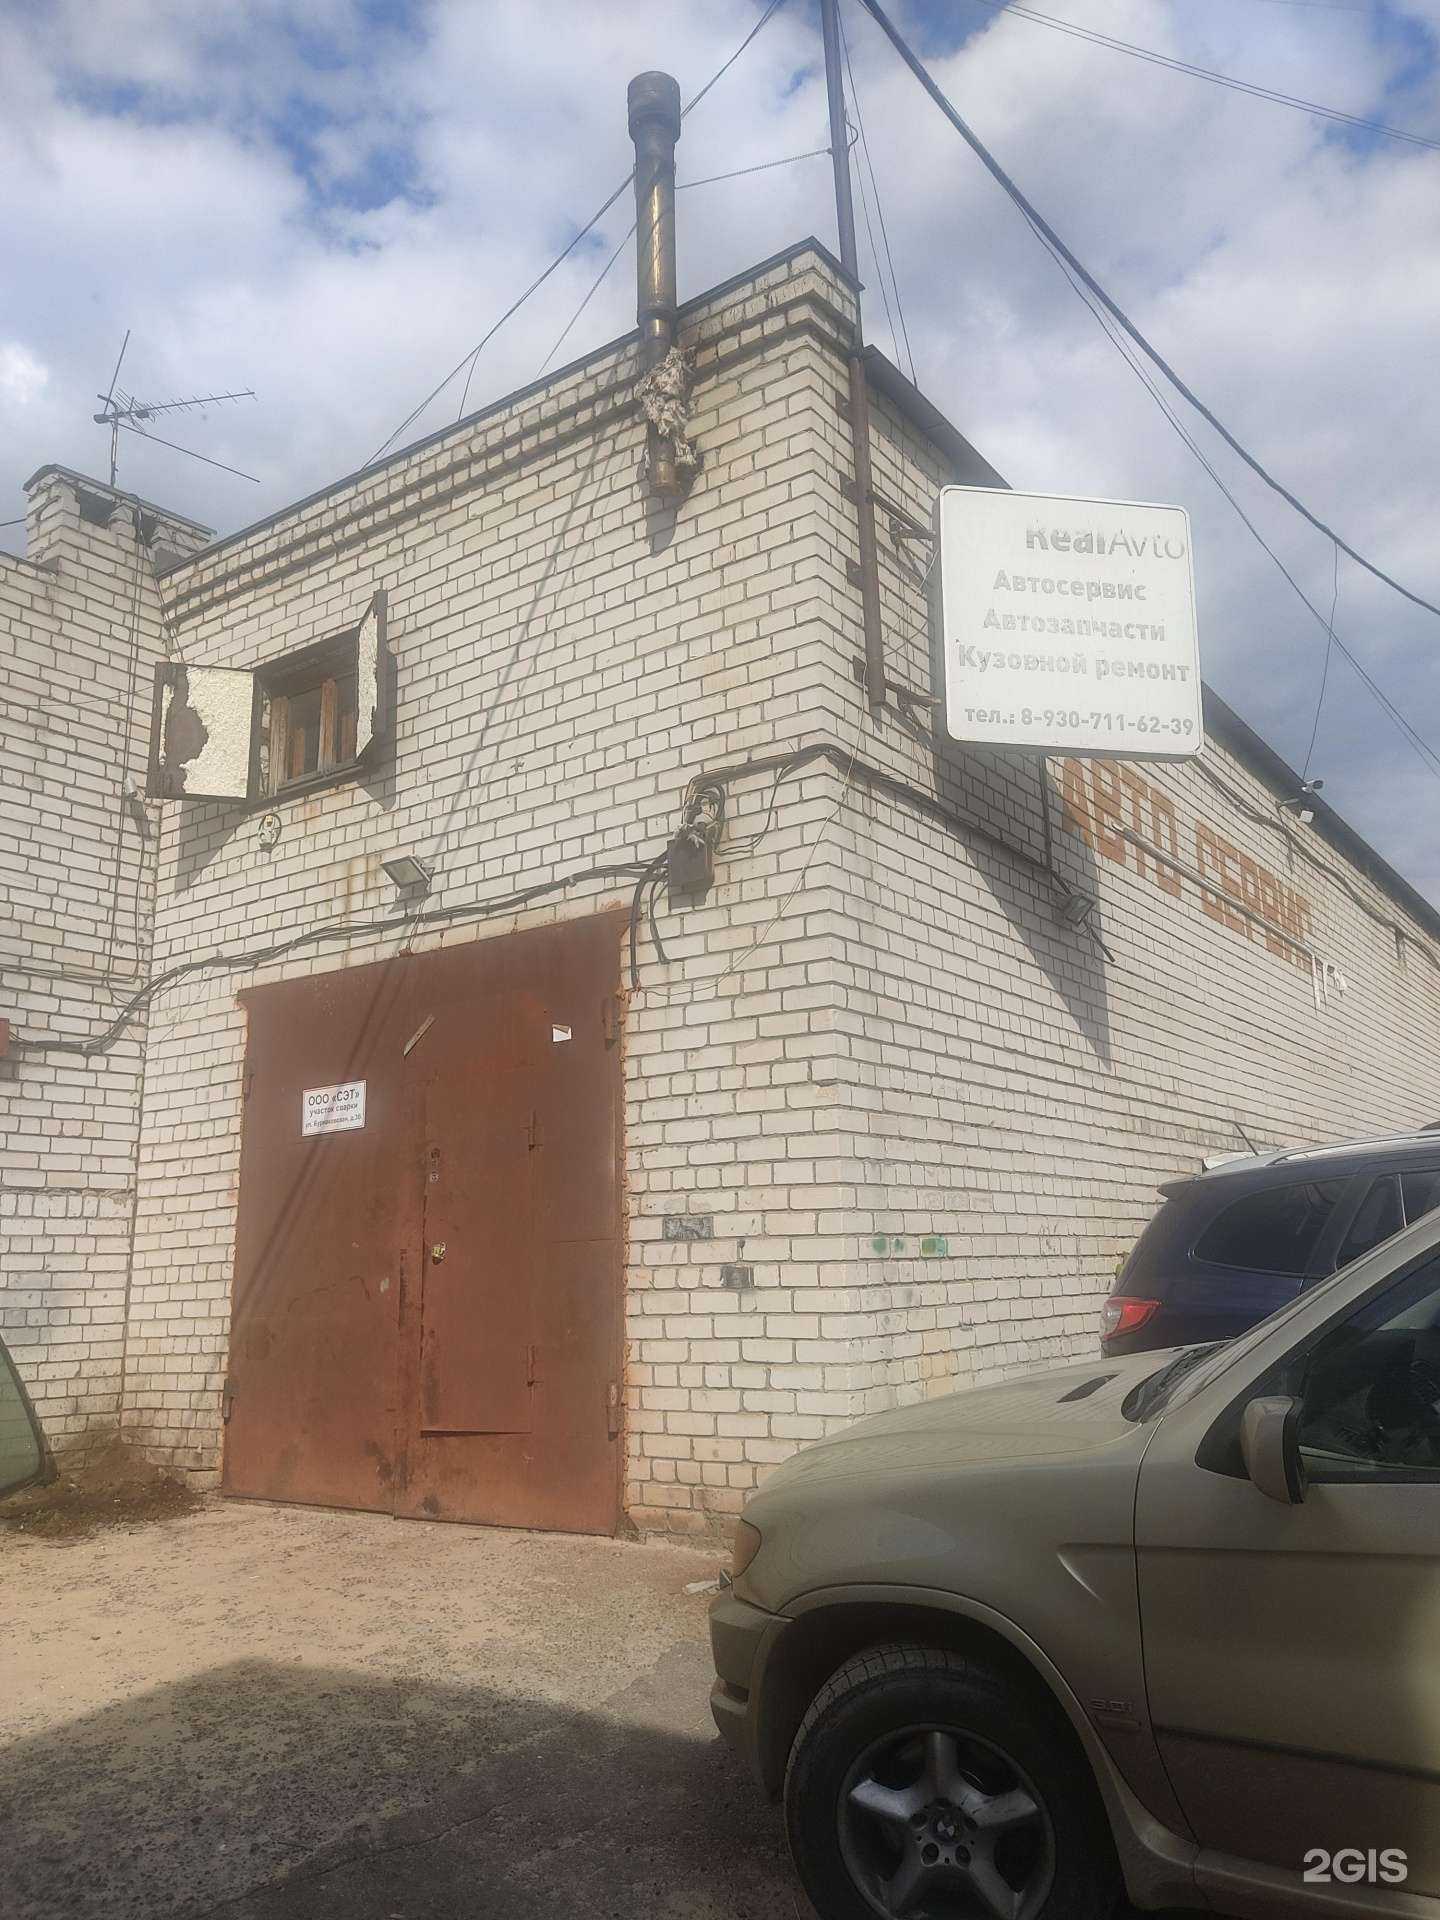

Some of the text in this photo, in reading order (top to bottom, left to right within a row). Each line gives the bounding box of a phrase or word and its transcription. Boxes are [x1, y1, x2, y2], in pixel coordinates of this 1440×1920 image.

[1026, 525, 1186, 560] RealAvto
[993, 569, 1147, 601] Автосервис
[983, 608, 1166, 641] Автозапчасти
[958, 644, 1191, 682] Кузовной ремонт
[965, 706, 1194, 736] тел.: 8-930-711-62-39
[308, 1089, 360, 1106] ООО «СЭТ»
[309, 1104, 358, 1118] участок сварки
